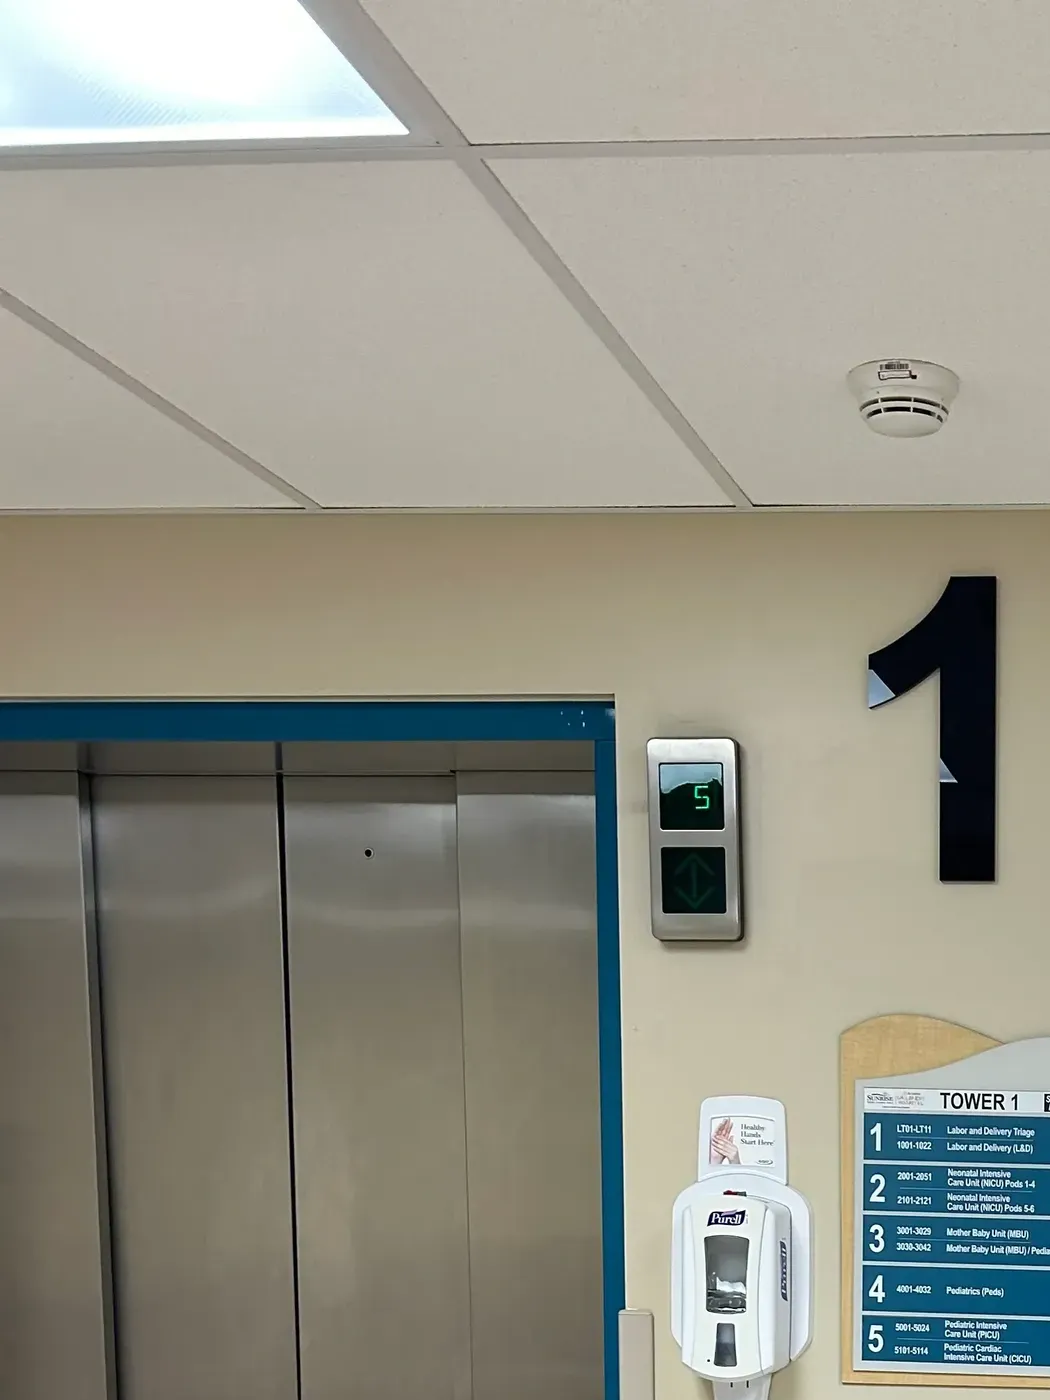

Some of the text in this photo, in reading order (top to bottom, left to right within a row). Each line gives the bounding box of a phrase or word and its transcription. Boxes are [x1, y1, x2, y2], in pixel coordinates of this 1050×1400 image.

[867, 575, 997, 883] 1
[694, 786, 710, 809] 5
[940, 1093, 1005, 1110] TOWER
[1012, 1094, 1018, 1110] 1
[870, 1122, 882, 1152] 1
[896, 1124, 1036, 1138] LT01-LT11 Labor and Delivery Triage
[896, 1141, 1034, 1154] 1001-1022 Labor and Delivery (L&D)
[898, 1172, 932, 1181] 2001-2051
[948, 1168, 1011, 1178] Neonatal Intensive
[870, 1174, 886, 1202] 2
[948, 1178, 1036, 1189] Care Unit (NICU) Pods 1-4
[897, 1196, 932, 1205] 2101-2121
[947, 1193, 1010, 1202] Neonatal Intensive
[947, 1202, 964, 1210] Care
[980, 1204, 1003, 1213] (NICU)
[1004, 1204, 1022, 1212] Pods
[869, 1224, 885, 1253] 3
[896, 1226, 1029, 1240] 3001-3029 Mother Baby Unit (MBU)
[946, 1244, 970, 1253] Mother
[971, 1245, 989, 1255] Baby
[990, 1246, 1005, 1254] Unit
[1006, 1246, 1027, 1256] (MBU)
[869, 1275, 885, 1302] 4
[896, 1285, 1004, 1297] 4001-4032 Pediatrics (Peds)
[895, 1323, 930, 1332] 5001-5024
[944, 1320, 1007, 1330] Pediatric Intensive
[868, 1325, 884, 1353] 5
[962, 1330, 976, 1338] Unit
[978, 1330, 1000, 1340] (PICU)
[894, 1346, 928, 1355] 5101-5114
[944, 1343, 1002, 1352] Pediatric Cardiac
[944, 1353, 974, 1361] Intensive
[976, 1354, 992, 1362] Care
[1009, 1355, 1032, 1364] (CICU)
